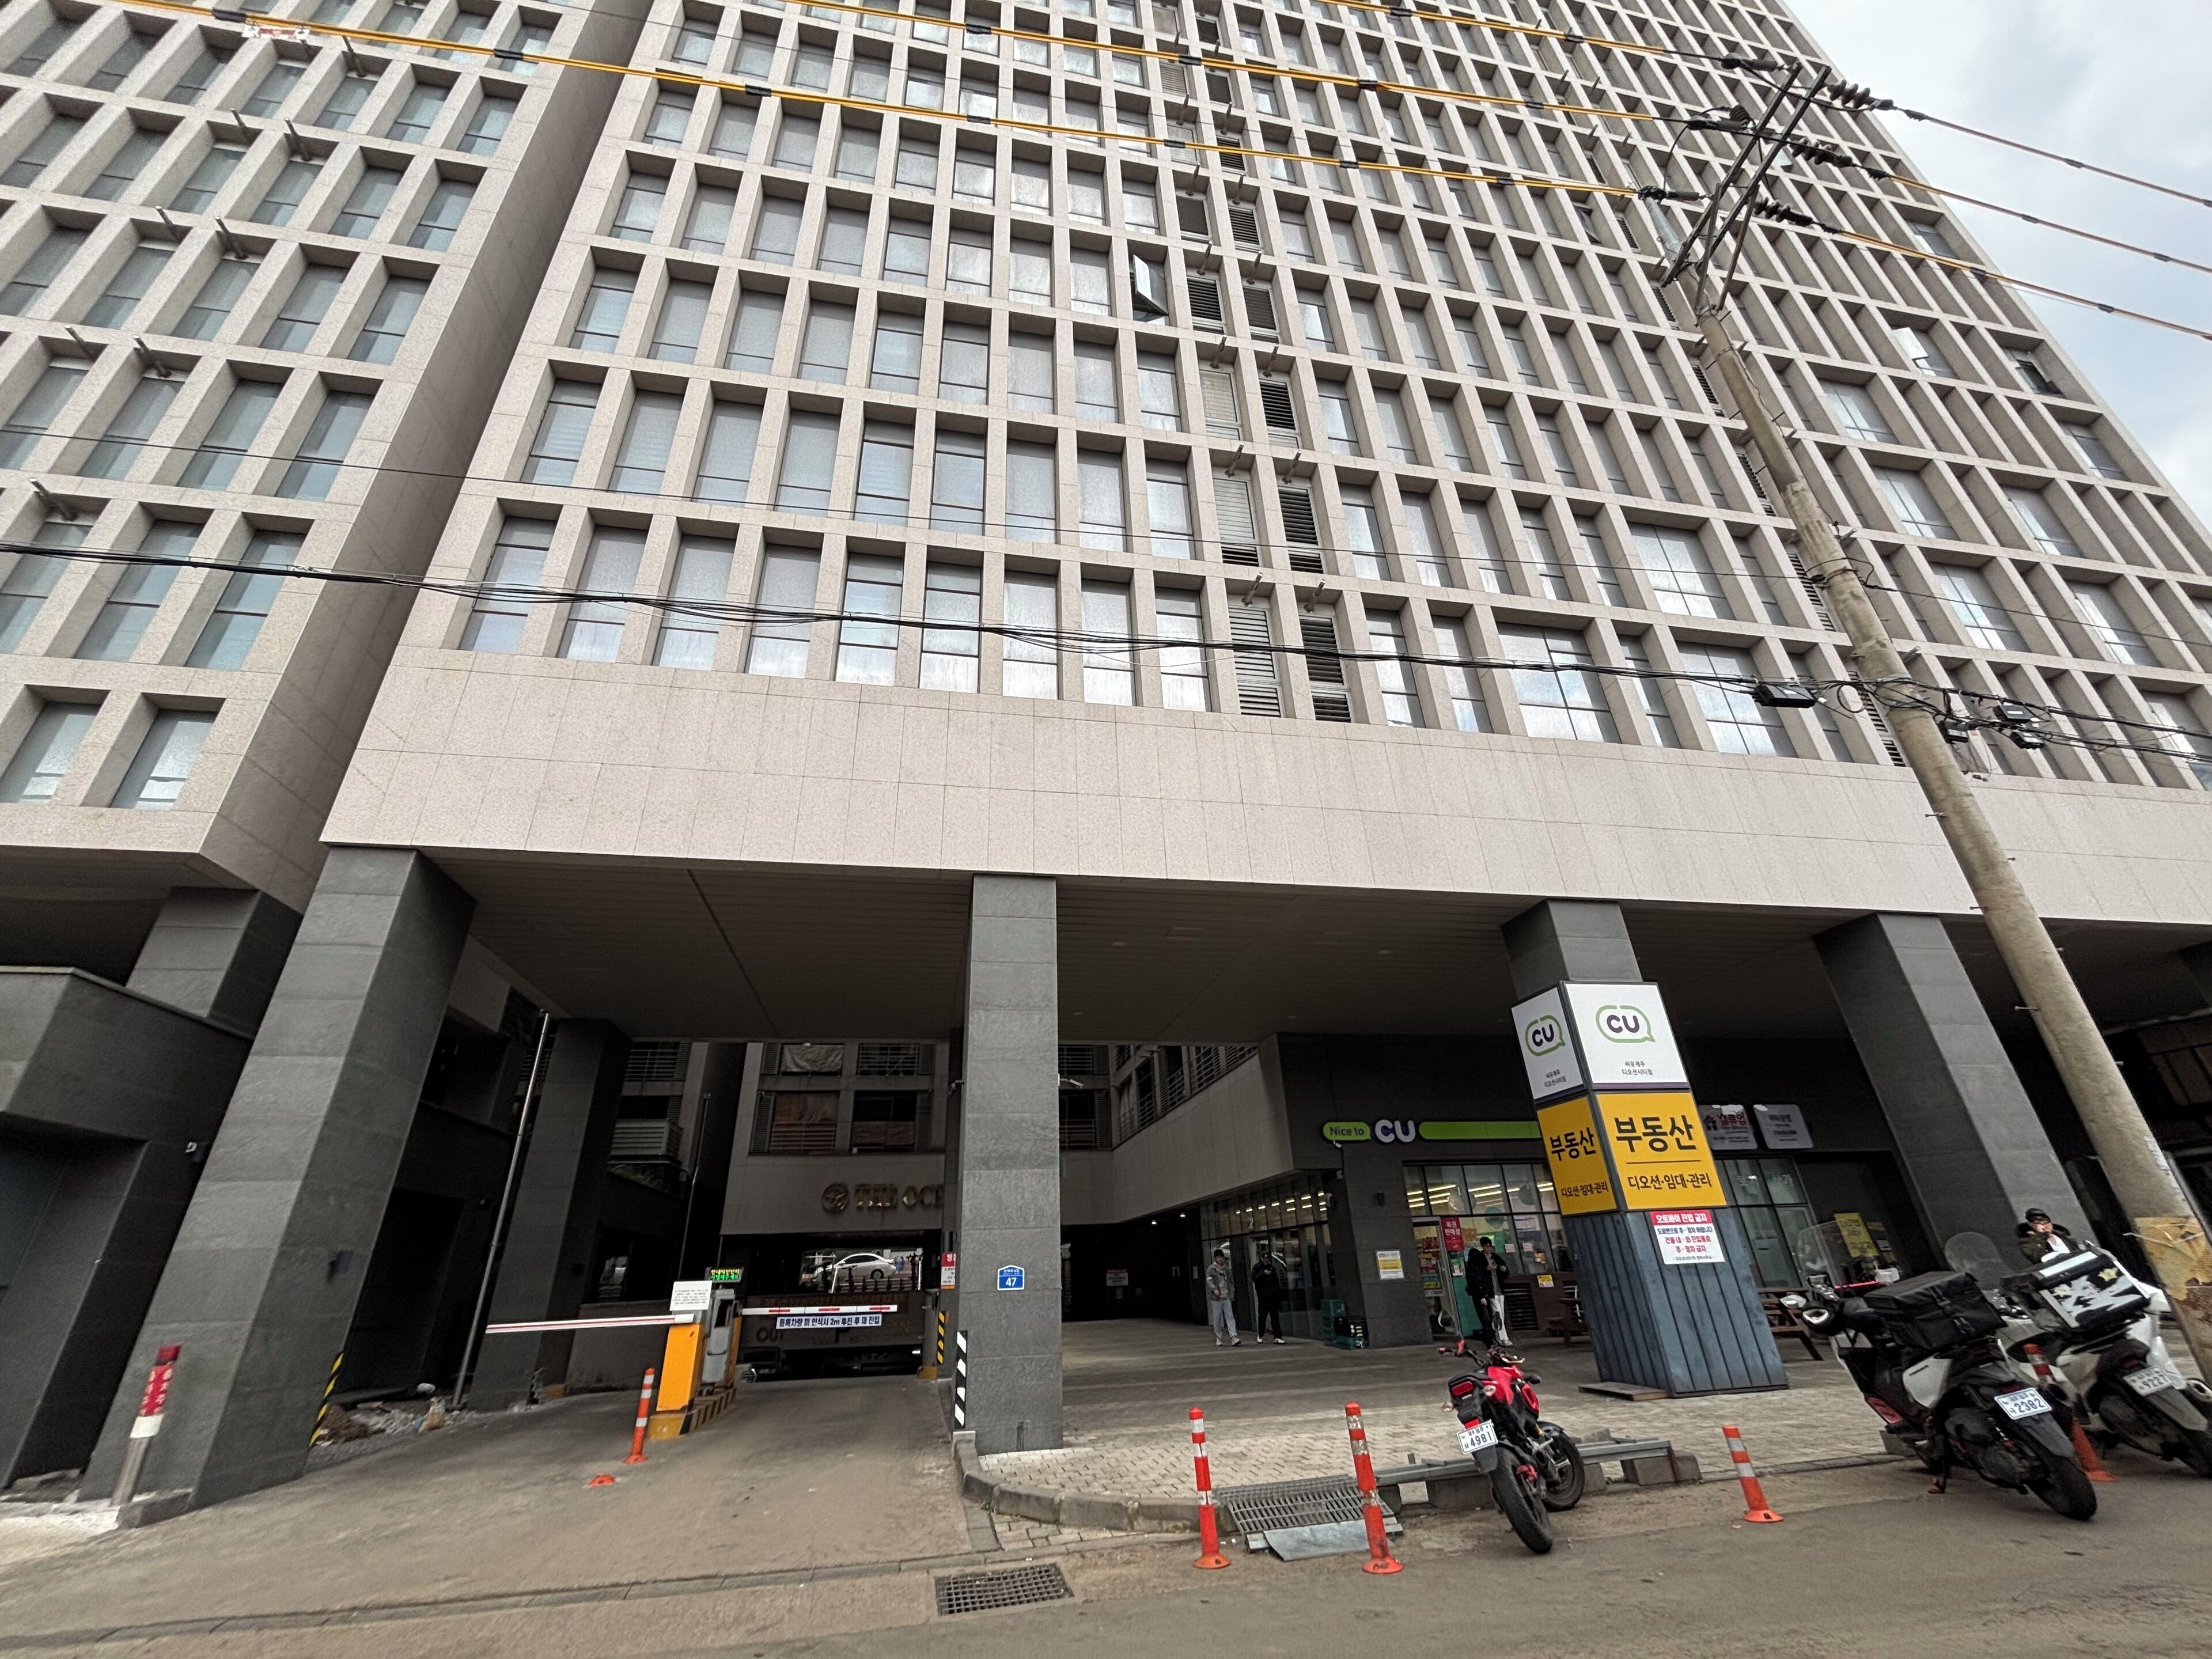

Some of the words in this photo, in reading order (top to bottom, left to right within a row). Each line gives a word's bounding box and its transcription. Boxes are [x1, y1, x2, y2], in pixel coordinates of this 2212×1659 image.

[1607, 1014, 1639, 1033] CU
[1532, 1024, 1554, 1047] CU
[1330, 1127, 1352, 1136] Nice
[1354, 1127, 1365, 1136] to
[1375, 1119, 1416, 1143] CU
[1614, 1115, 1697, 1153] 부동산
[1550, 1127, 1596, 1161] 부동산
[854, 1184, 898, 1210] THE
[1656, 1214, 1681, 1224] 오토바이
[1680, 1213, 1695, 1222] 진입
[1694, 1213, 1708, 1222] 금지
[1005, 1277, 1017, 1286] 47
[779, 1319, 803, 1327] 등록차량
[804, 1318, 810, 1326] 미
[812, 1317, 828, 1326] 인식시
[841, 1317, 853, 1325] 후진
[854, 1317, 860, 1325] 후
[861, 1316, 867, 1325] 재
[869, 1316, 880, 1325] 진입
[2014, 1398, 2046, 1413] 2382
[1471, 1431, 1492, 1446] 4981
